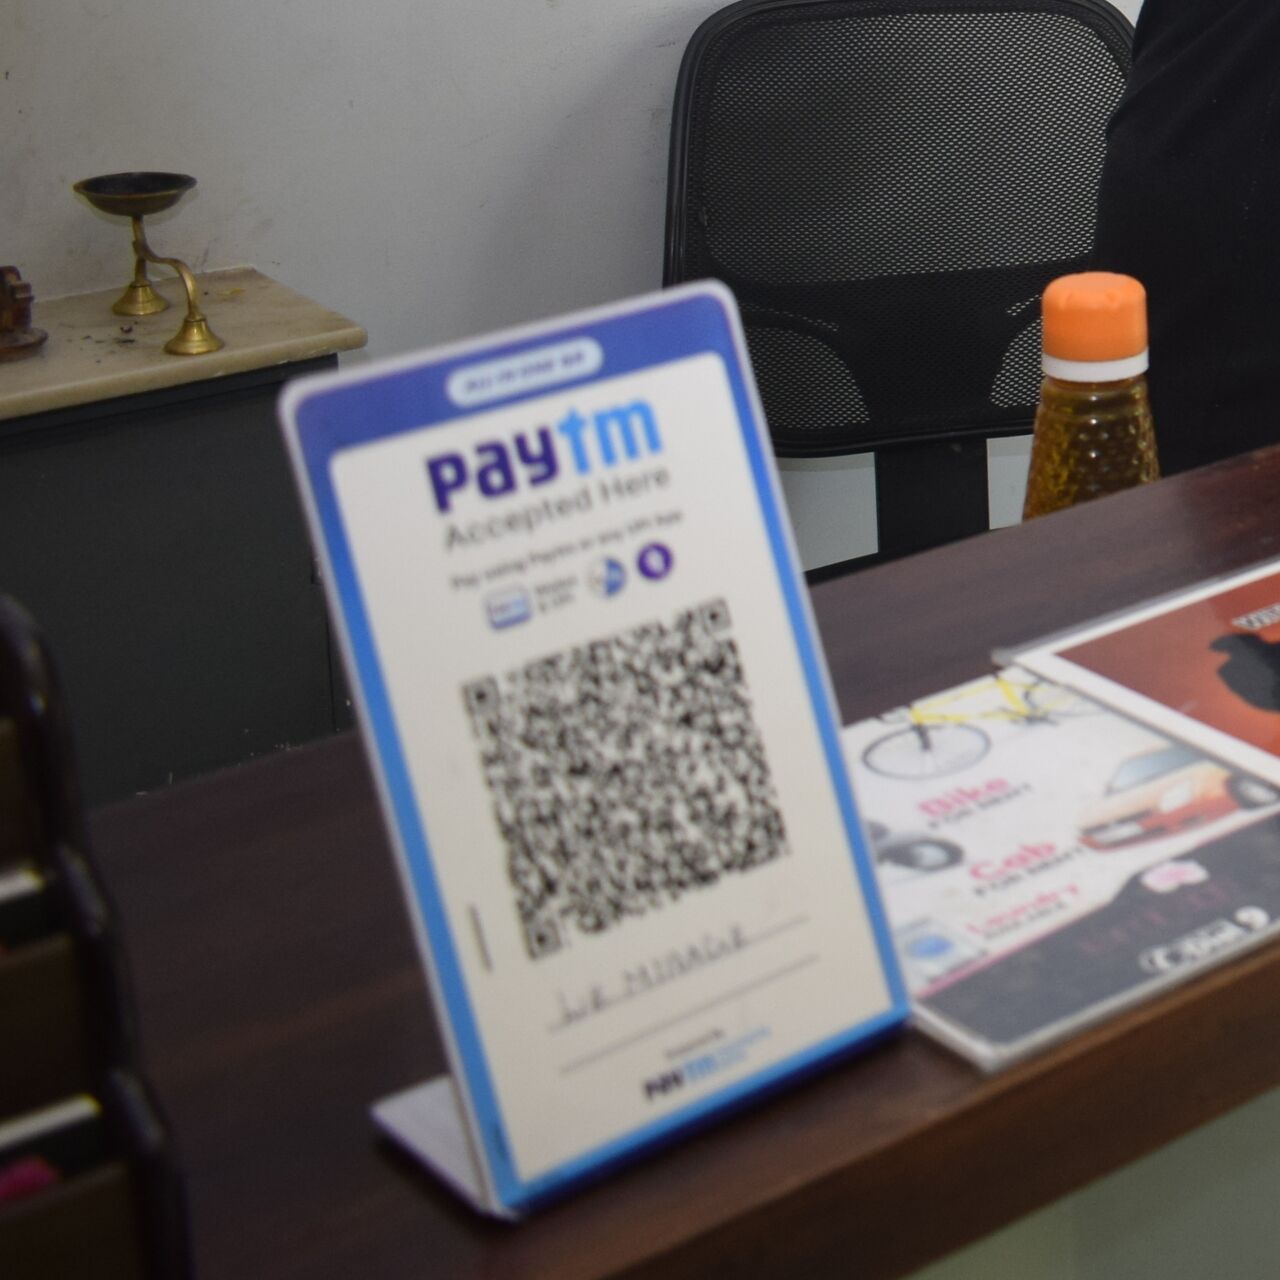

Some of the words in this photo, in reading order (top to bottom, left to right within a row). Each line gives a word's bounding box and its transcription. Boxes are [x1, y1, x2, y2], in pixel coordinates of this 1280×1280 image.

[446, 487, 595, 553] Accepted
[600, 466, 671, 504] Here
[920, 777, 1010, 818] Bike
[968, 841, 1057, 880] Cab
